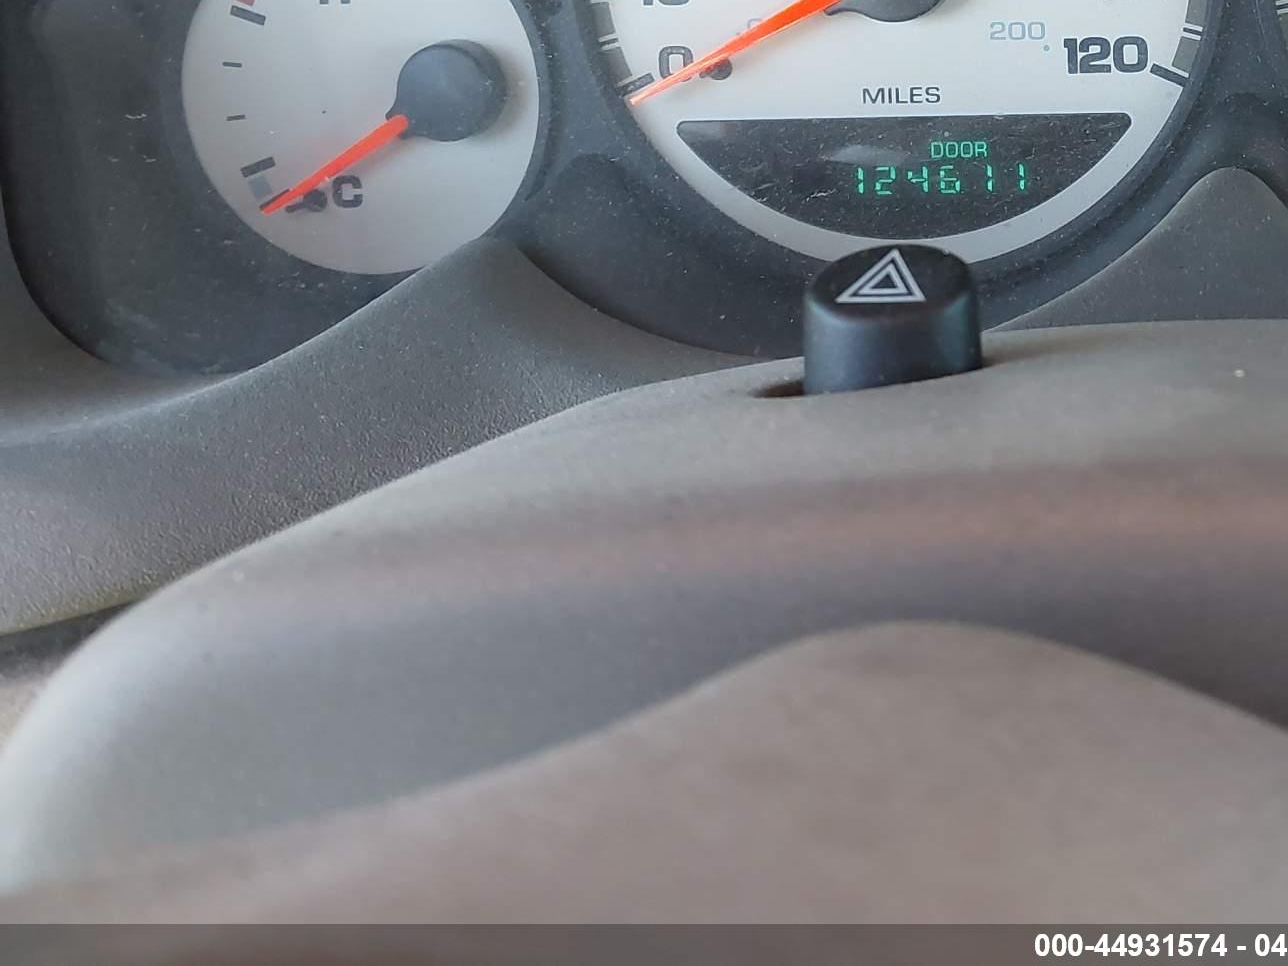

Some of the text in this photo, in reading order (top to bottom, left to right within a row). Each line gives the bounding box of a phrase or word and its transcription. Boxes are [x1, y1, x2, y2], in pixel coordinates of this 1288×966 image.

[989, 21, 1045, 40] 200
[1063, 36, 1148, 74] 120
[862, 86, 941, 106] MILES
[930, 140, 989, 160] DOOR
[332, 175, 363, 209] C
[853, 164, 1028, 195] 124611
